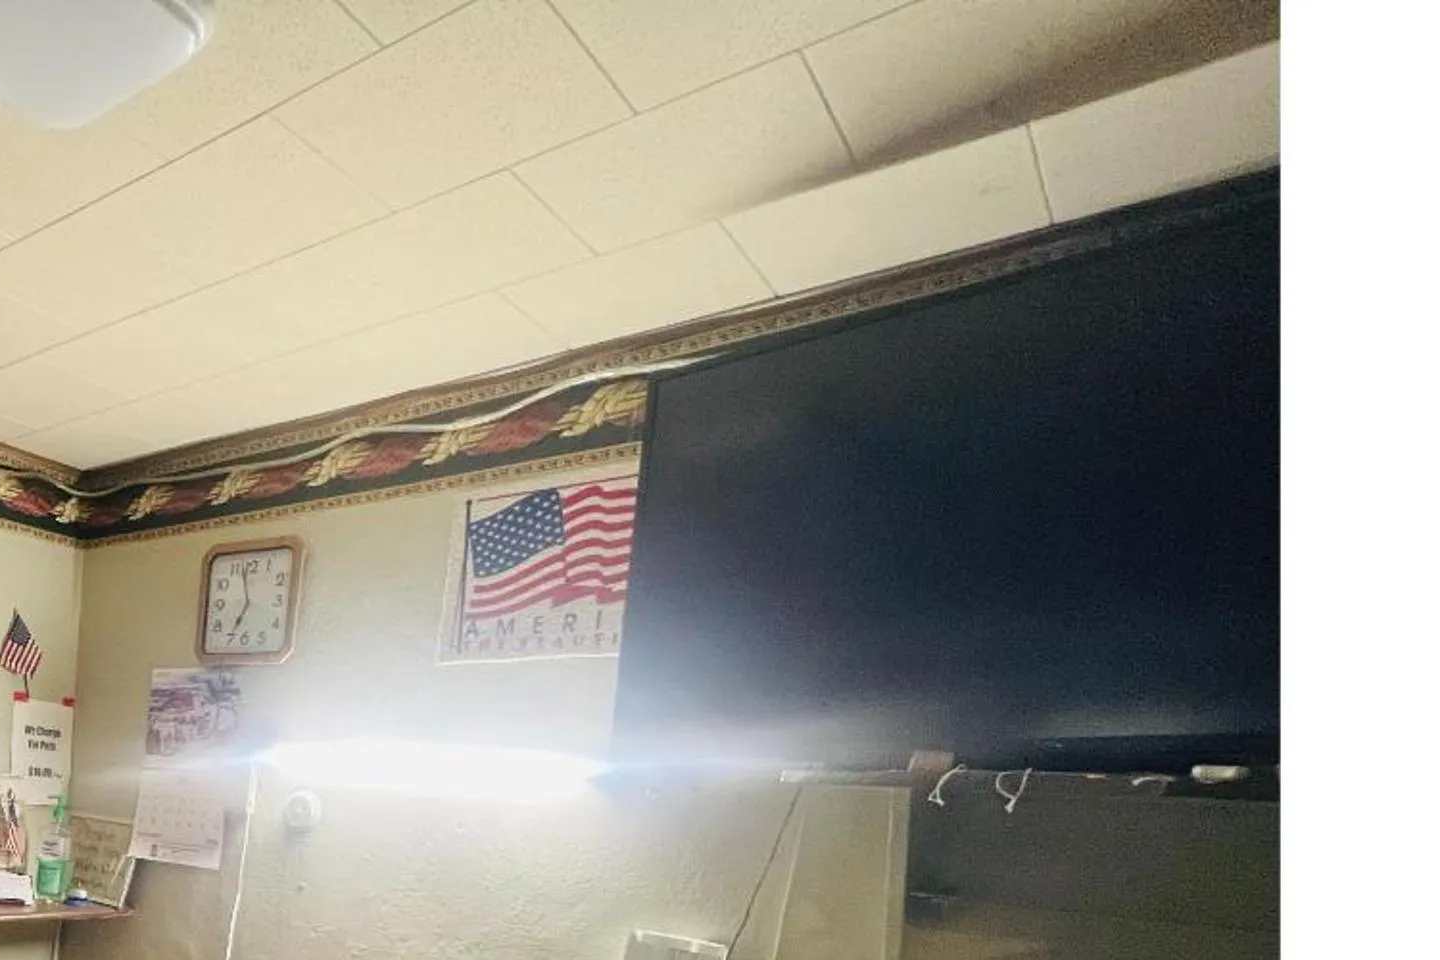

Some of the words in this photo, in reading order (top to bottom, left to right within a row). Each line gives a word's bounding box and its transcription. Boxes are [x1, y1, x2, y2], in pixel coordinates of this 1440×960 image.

[275, 572, 285, 587] 2
[214, 598, 225, 612] 9
[271, 593, 283, 608] 3
[212, 619, 222, 633] 8
[271, 617, 280, 630] 4
[465, 609, 602, 640] AMERI
[226, 632, 237, 646] 7
[240, 630, 250, 645] 6
[256, 630, 266, 644] 5
